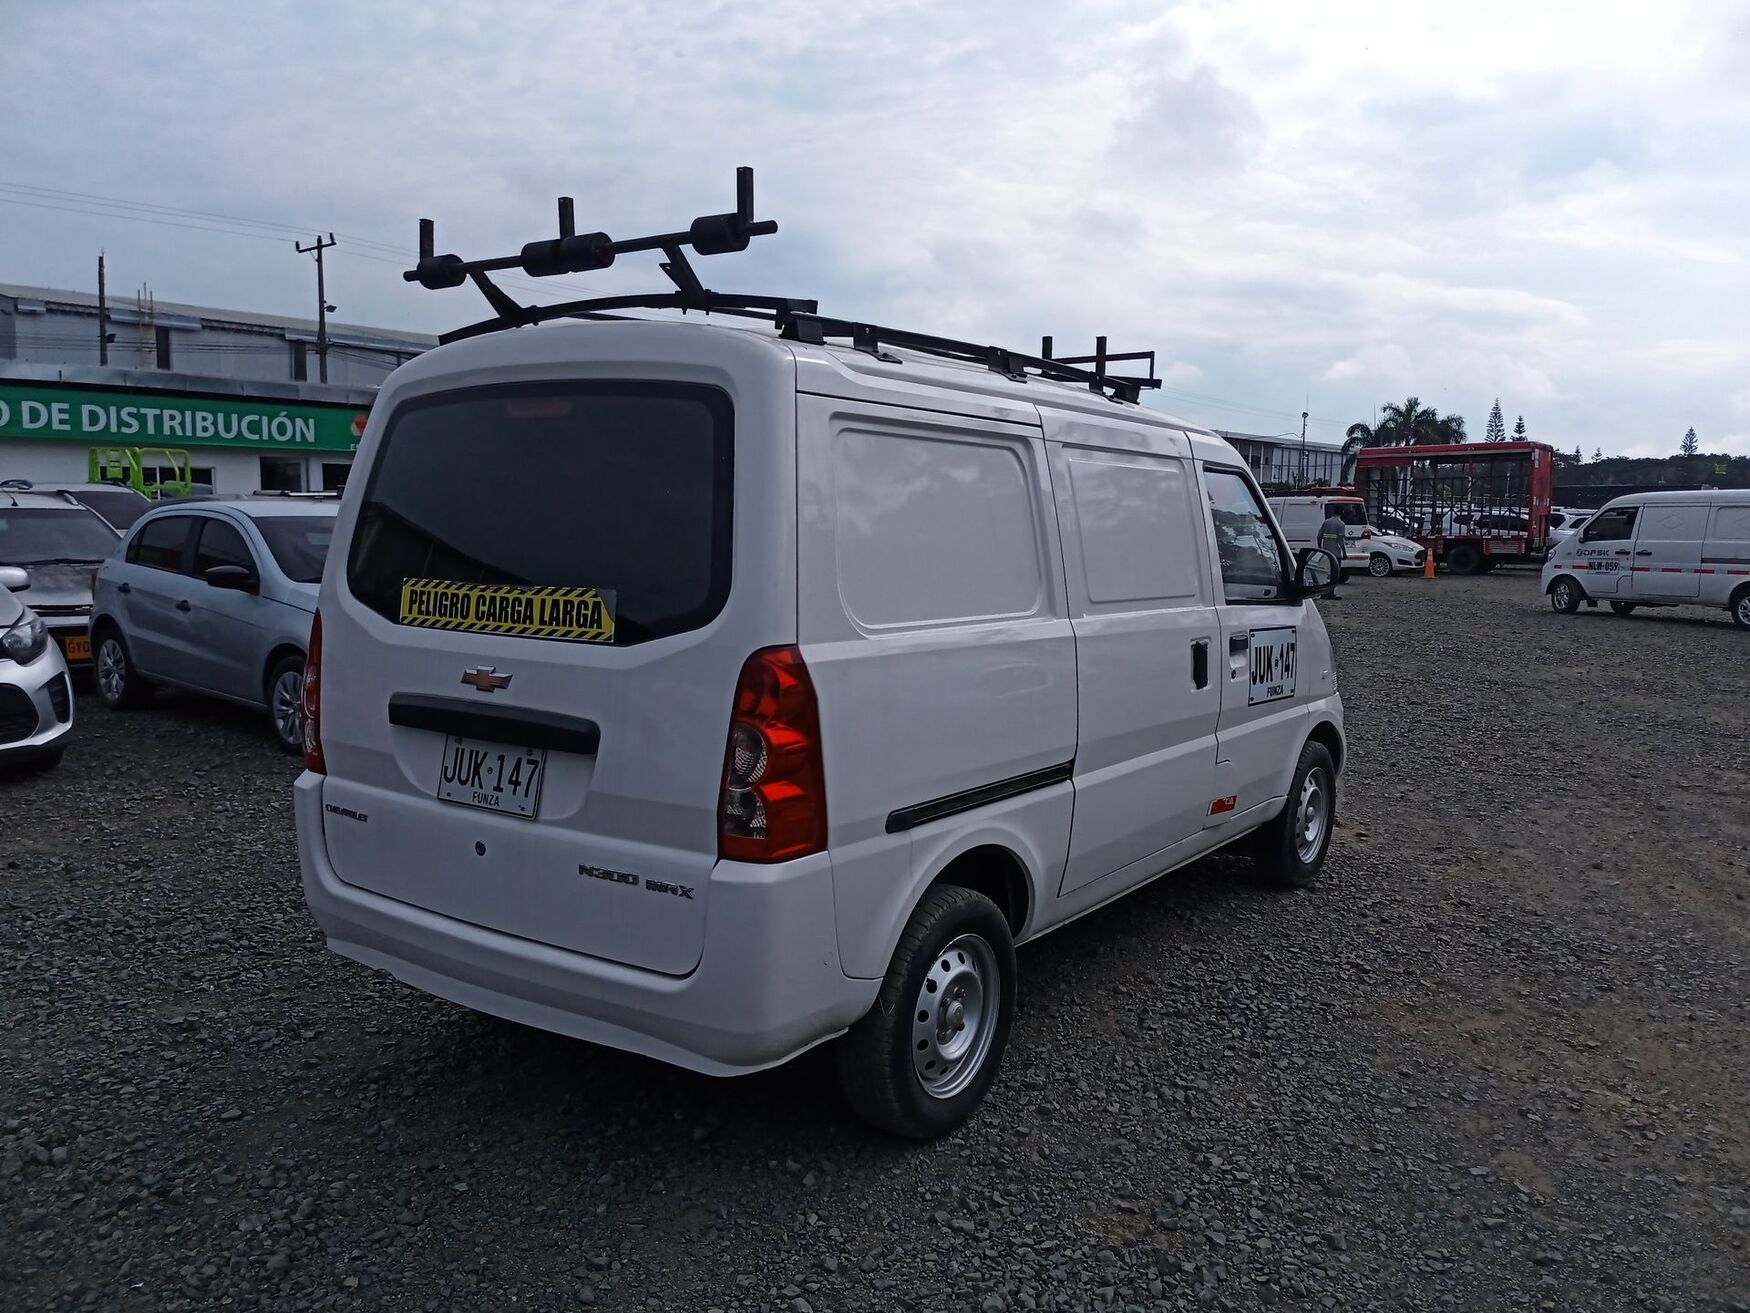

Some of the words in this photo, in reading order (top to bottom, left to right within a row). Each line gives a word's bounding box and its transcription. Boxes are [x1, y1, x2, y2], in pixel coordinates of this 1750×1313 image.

[21, 400, 71, 431] DE
[81, 404, 315, 442] DISTRIBUCIÓN
[408, 589, 471, 620] PELIGRO
[474, 594, 534, 626] CARGA
[538, 598, 602, 629] LARGA
[472, 791, 500, 807] FUNZA
